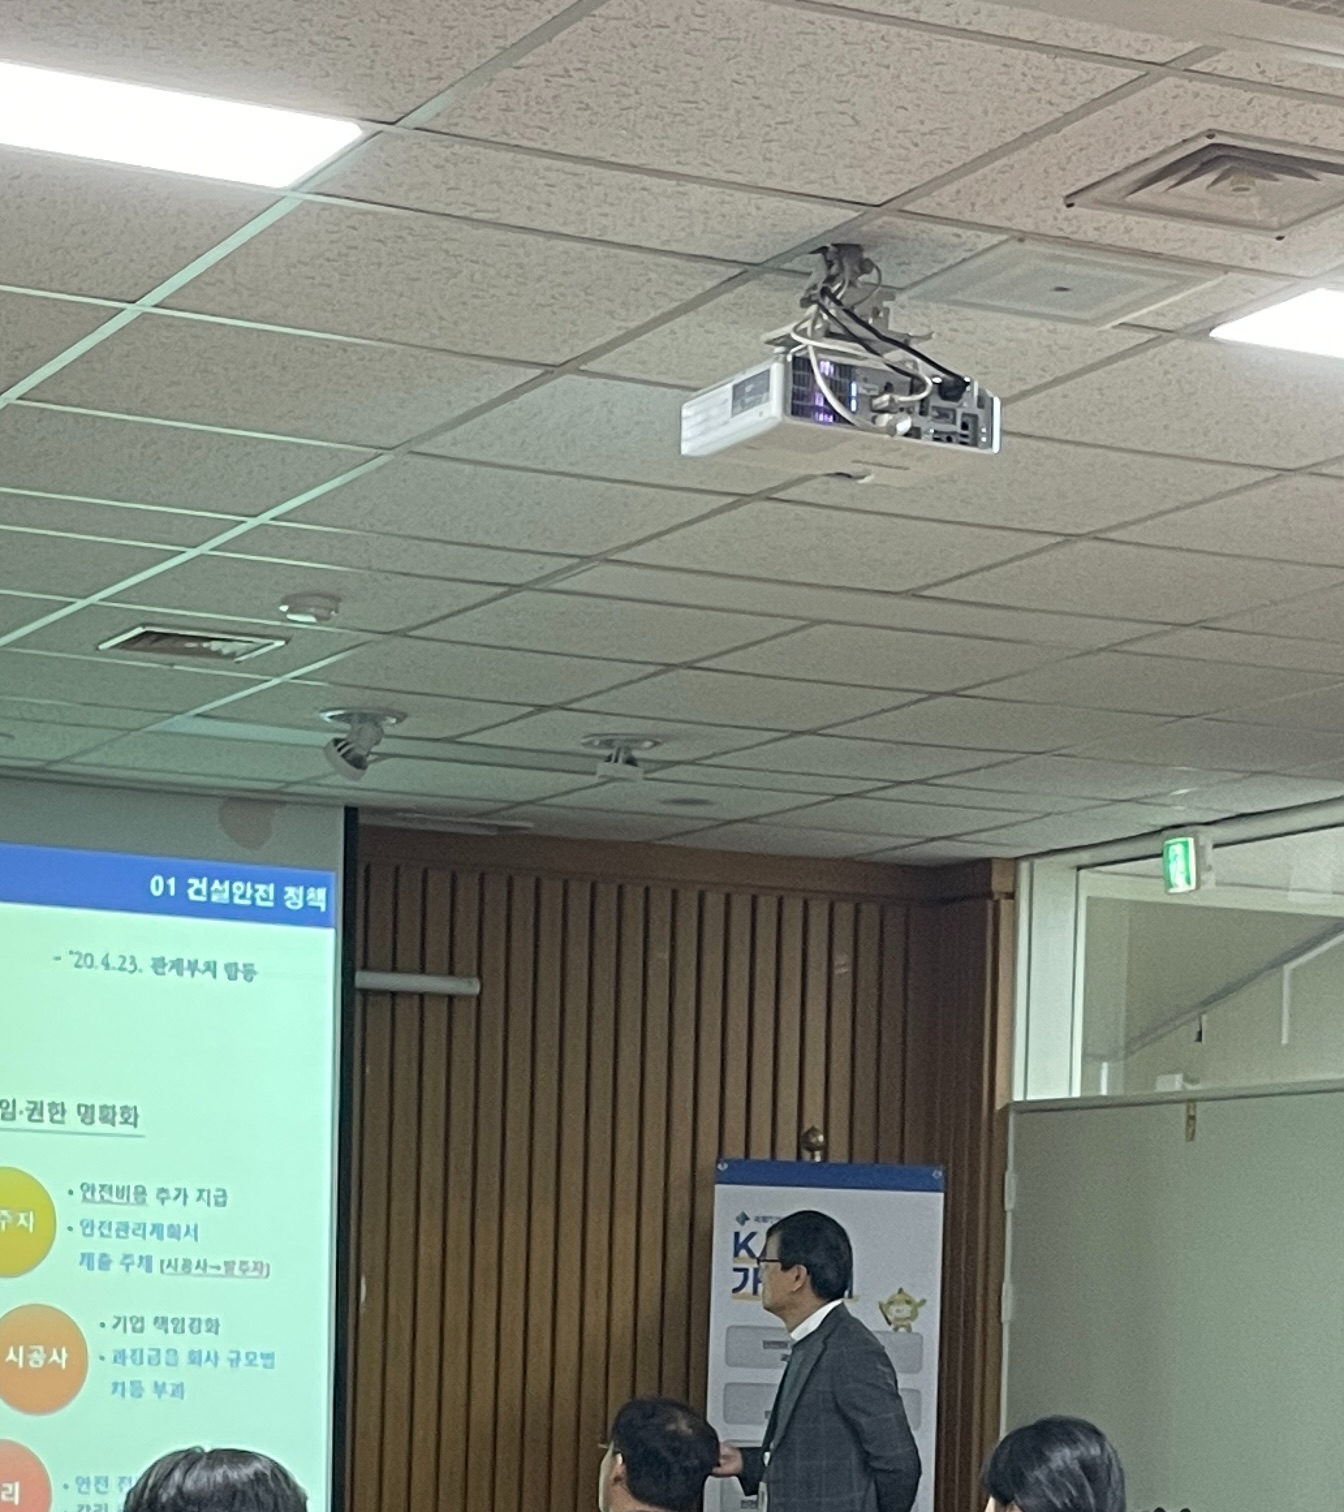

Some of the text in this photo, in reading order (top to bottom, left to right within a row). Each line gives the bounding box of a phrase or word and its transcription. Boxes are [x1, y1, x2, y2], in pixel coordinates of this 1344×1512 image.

[149, 873, 328, 913] 01 건설안전 정책
[195, 1187, 228, 1208] 지급
[111, 1315, 146, 1334] 기업
[4, 1344, 70, 1371] 시공사
